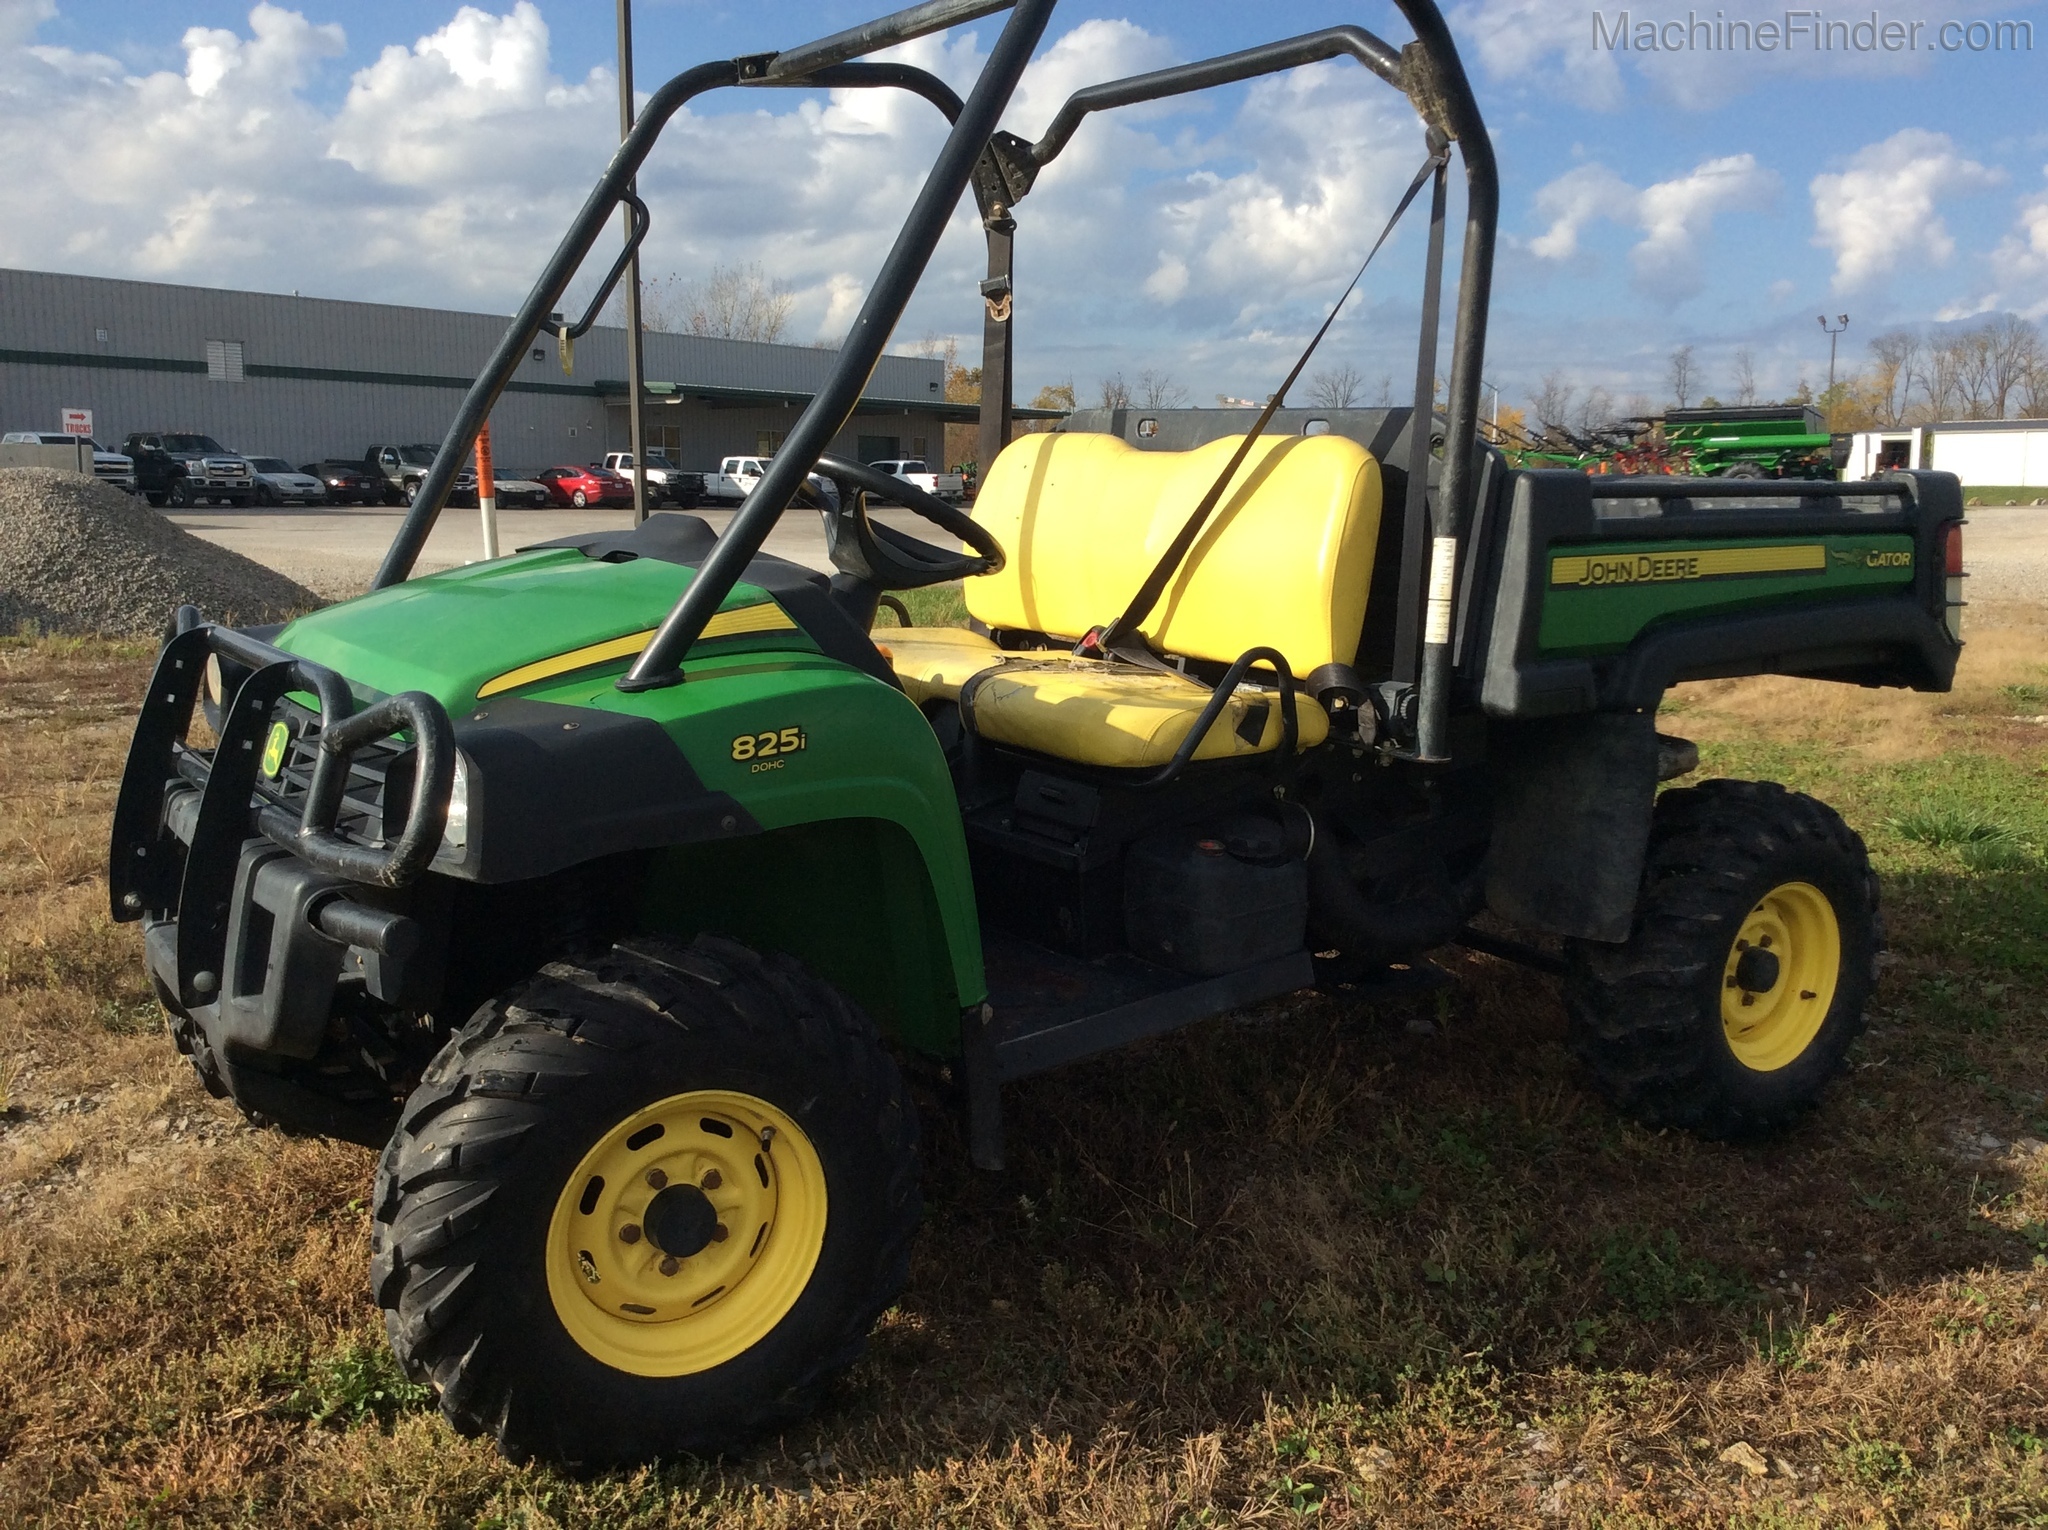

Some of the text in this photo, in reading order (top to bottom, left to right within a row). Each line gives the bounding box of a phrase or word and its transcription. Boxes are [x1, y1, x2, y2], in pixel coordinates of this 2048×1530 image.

[65, 423, 92, 434] TRUCKS
[1866, 549, 1912, 568] GATOR
[1579, 556, 1699, 583] JOHN DEERE
[731, 726, 807, 761] 825i
[751, 759, 785, 774] DOHC
